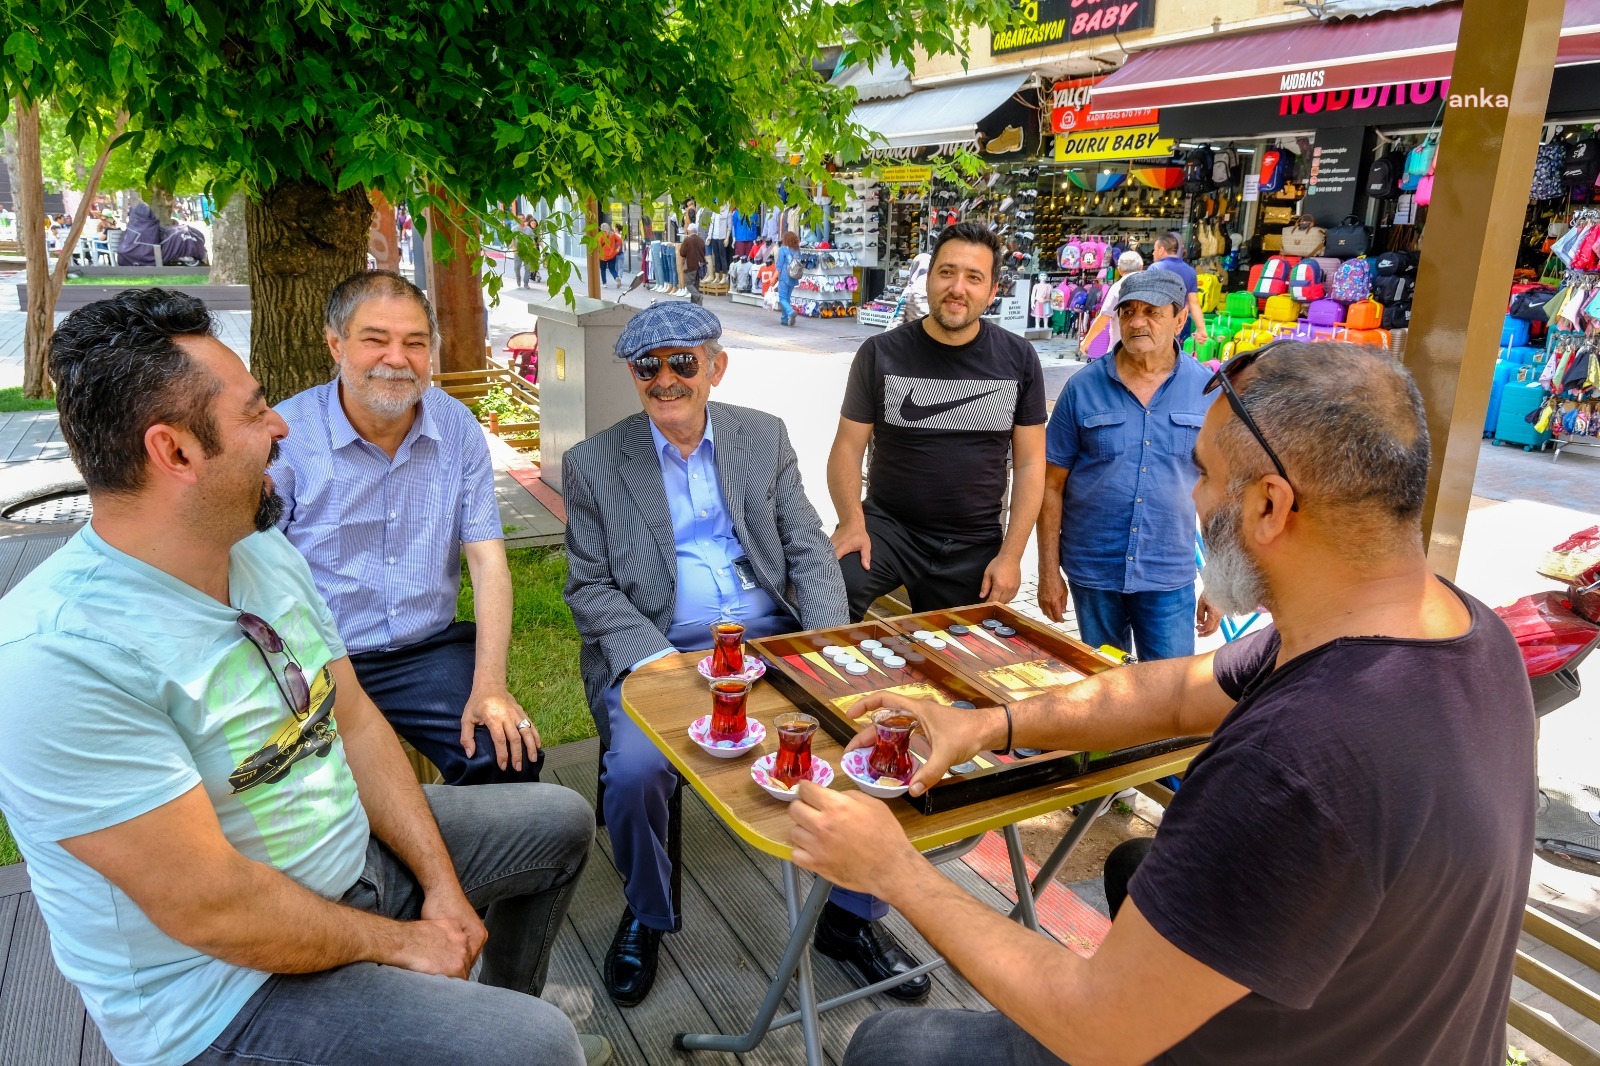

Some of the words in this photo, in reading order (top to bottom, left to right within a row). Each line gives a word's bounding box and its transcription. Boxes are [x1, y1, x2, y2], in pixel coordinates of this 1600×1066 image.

[1071, 2, 1139, 35] BABY
[1064, 136, 1109, 155] DURU
[1112, 132, 1159, 152] BABY
